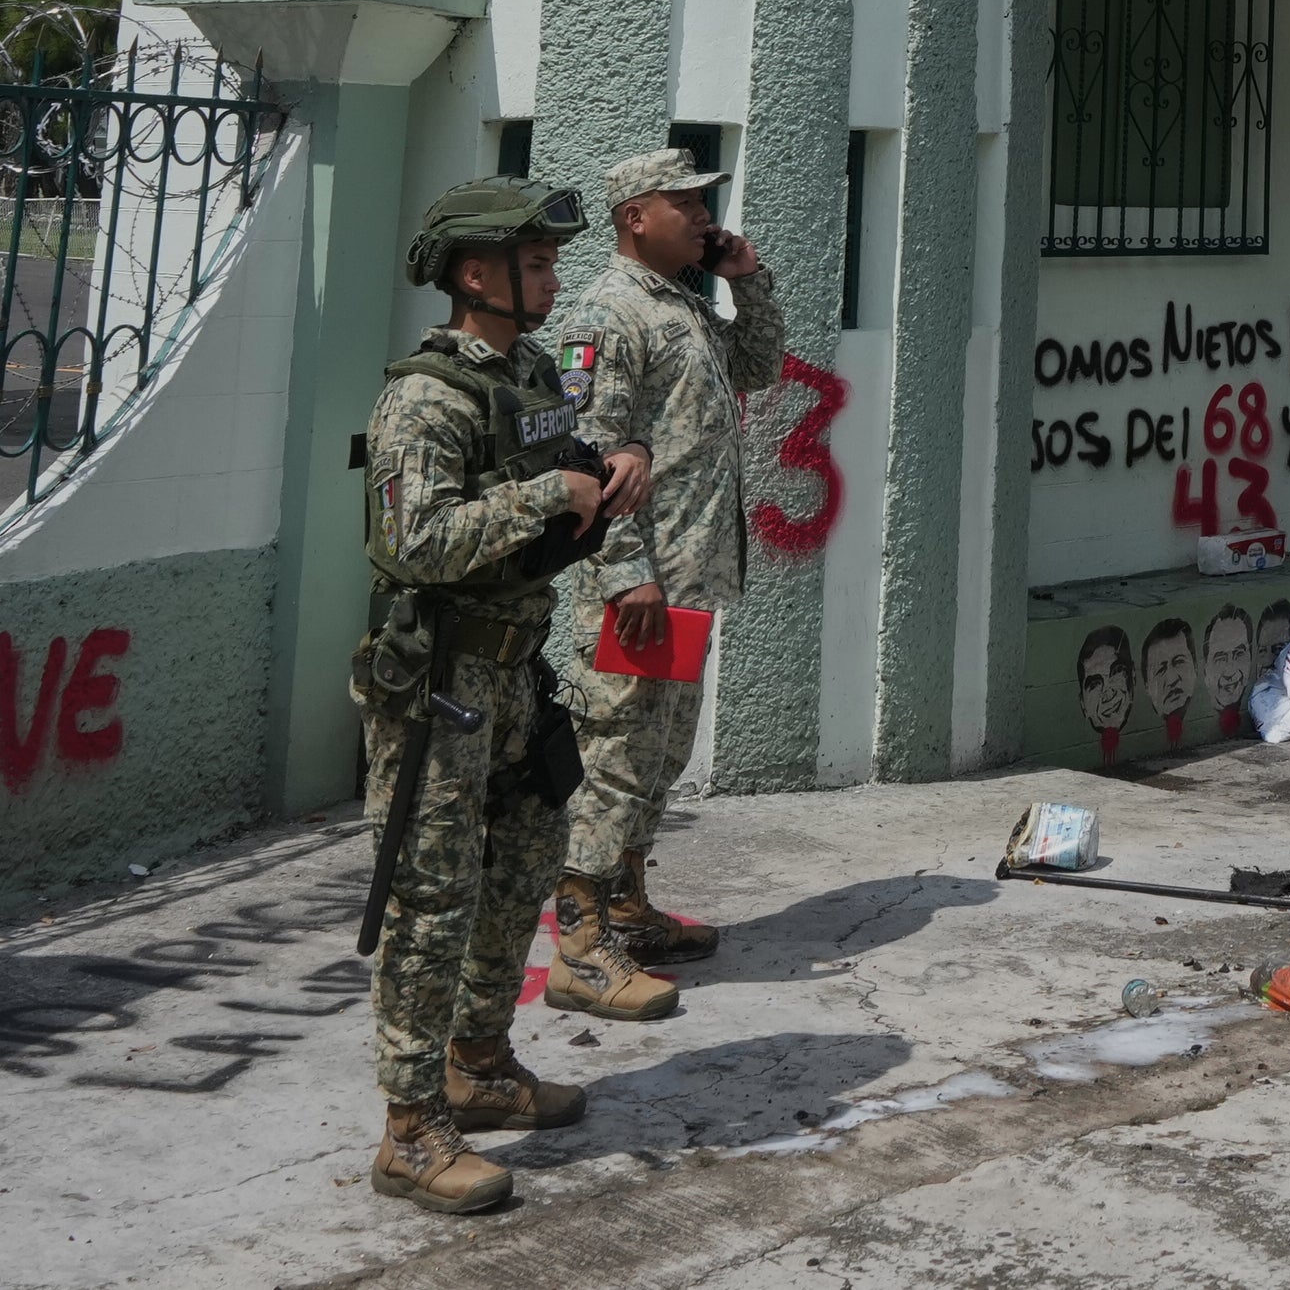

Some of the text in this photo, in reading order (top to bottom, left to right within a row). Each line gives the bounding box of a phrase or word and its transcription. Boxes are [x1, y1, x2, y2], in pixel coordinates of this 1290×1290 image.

[1035, 338, 1153, 387] OMOS
[521, 403, 576, 444] EJÉRCITO
[1031, 411, 1112, 472] JOS
[1203, 382, 1273, 457] 68
[1173, 457, 1279, 537] 43
